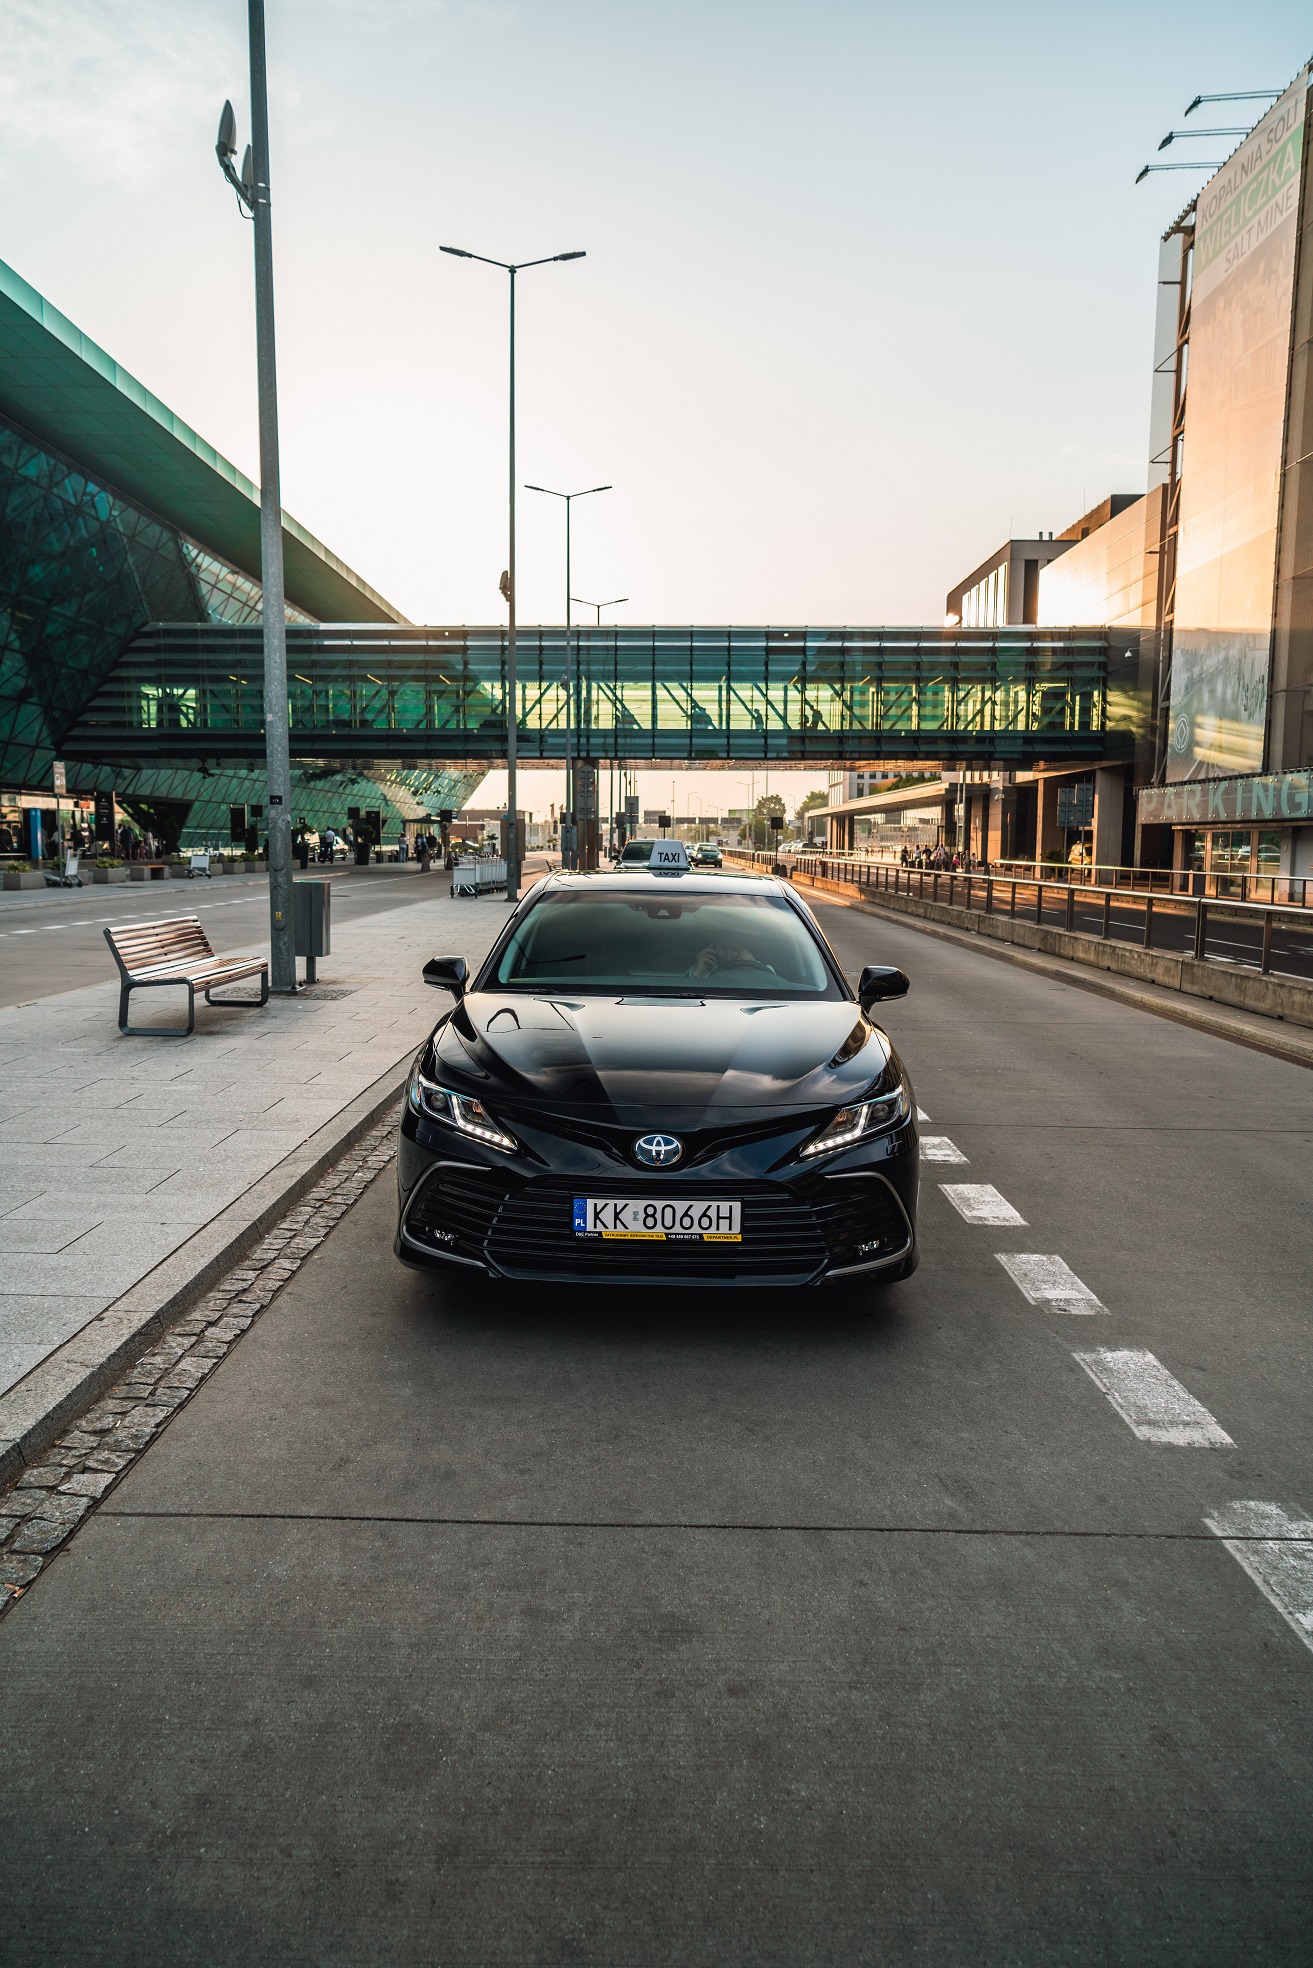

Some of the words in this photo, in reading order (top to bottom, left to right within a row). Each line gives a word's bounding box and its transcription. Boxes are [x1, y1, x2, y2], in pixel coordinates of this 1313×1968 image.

[1201, 143, 1262, 228] KOPALNIA
[1266, 98, 1299, 154] SOLI
[1199, 141, 1296, 267] WIELICZKA
[1224, 224, 1255, 273] SALT
[1256, 184, 1294, 243] MINE
[1142, 771, 1309, 823] PARKING
[658, 852, 680, 863] TAXI
[575, 1218, 586, 1227] PL
[593, 1203, 630, 1230] KK
[642, 1203, 733, 1231] 8066H
